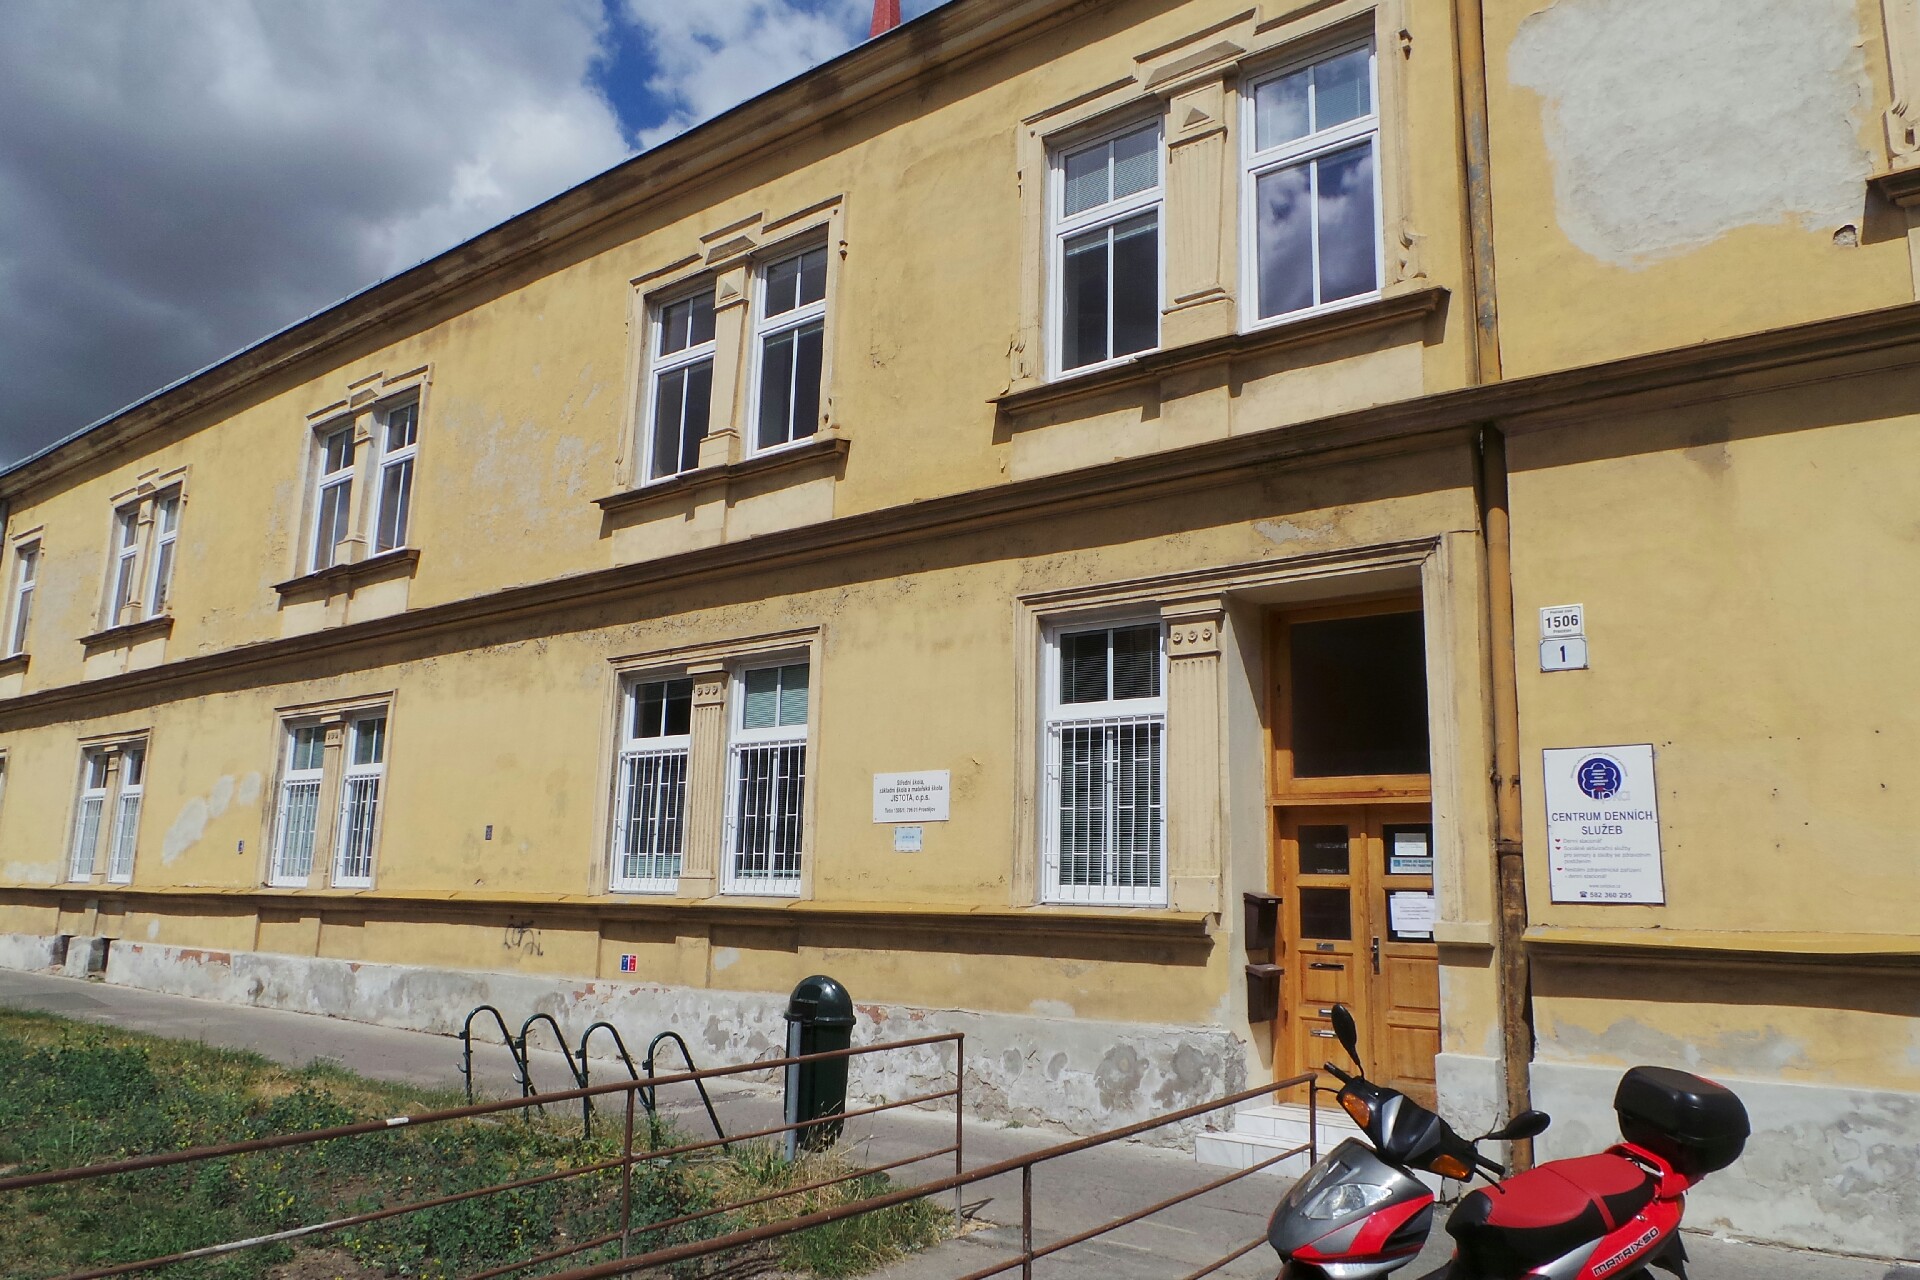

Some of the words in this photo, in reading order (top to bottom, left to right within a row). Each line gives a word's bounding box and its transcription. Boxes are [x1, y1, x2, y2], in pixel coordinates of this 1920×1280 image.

[1545, 614, 1579, 629] 1506
[1559, 645, 1566, 663] 1
[1551, 812, 1601, 822] CENTRUM
[1604, 809, 1653, 821] DENNÍCH
[1581, 824, 1623, 835] SLUŽEB
